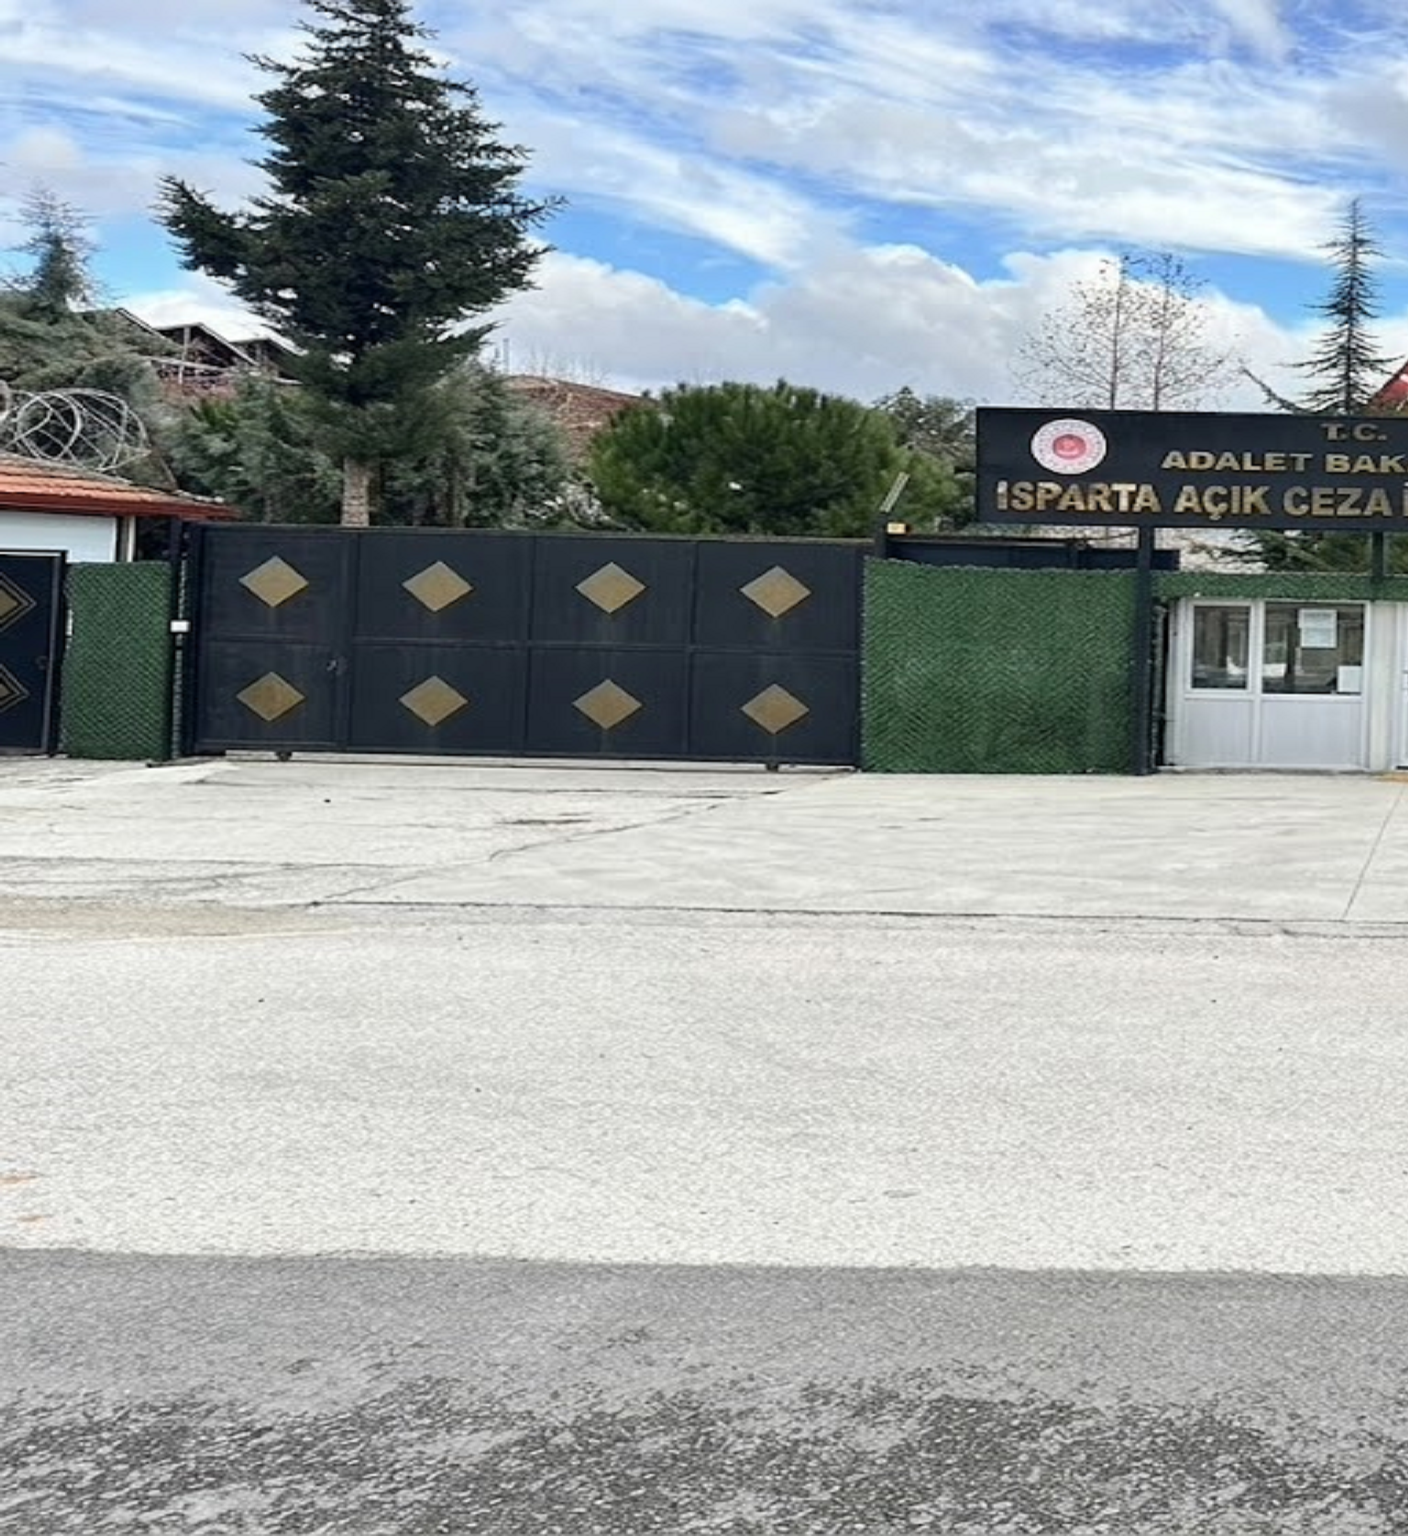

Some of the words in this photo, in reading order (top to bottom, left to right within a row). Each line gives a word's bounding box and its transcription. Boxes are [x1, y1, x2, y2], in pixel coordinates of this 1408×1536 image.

[1160, 450, 1314, 472] ADALET
[996, 480, 1162, 514] ISPARTA
[1173, 484, 1272, 521] AÇIK
[1283, 486, 1393, 517] CEZA
